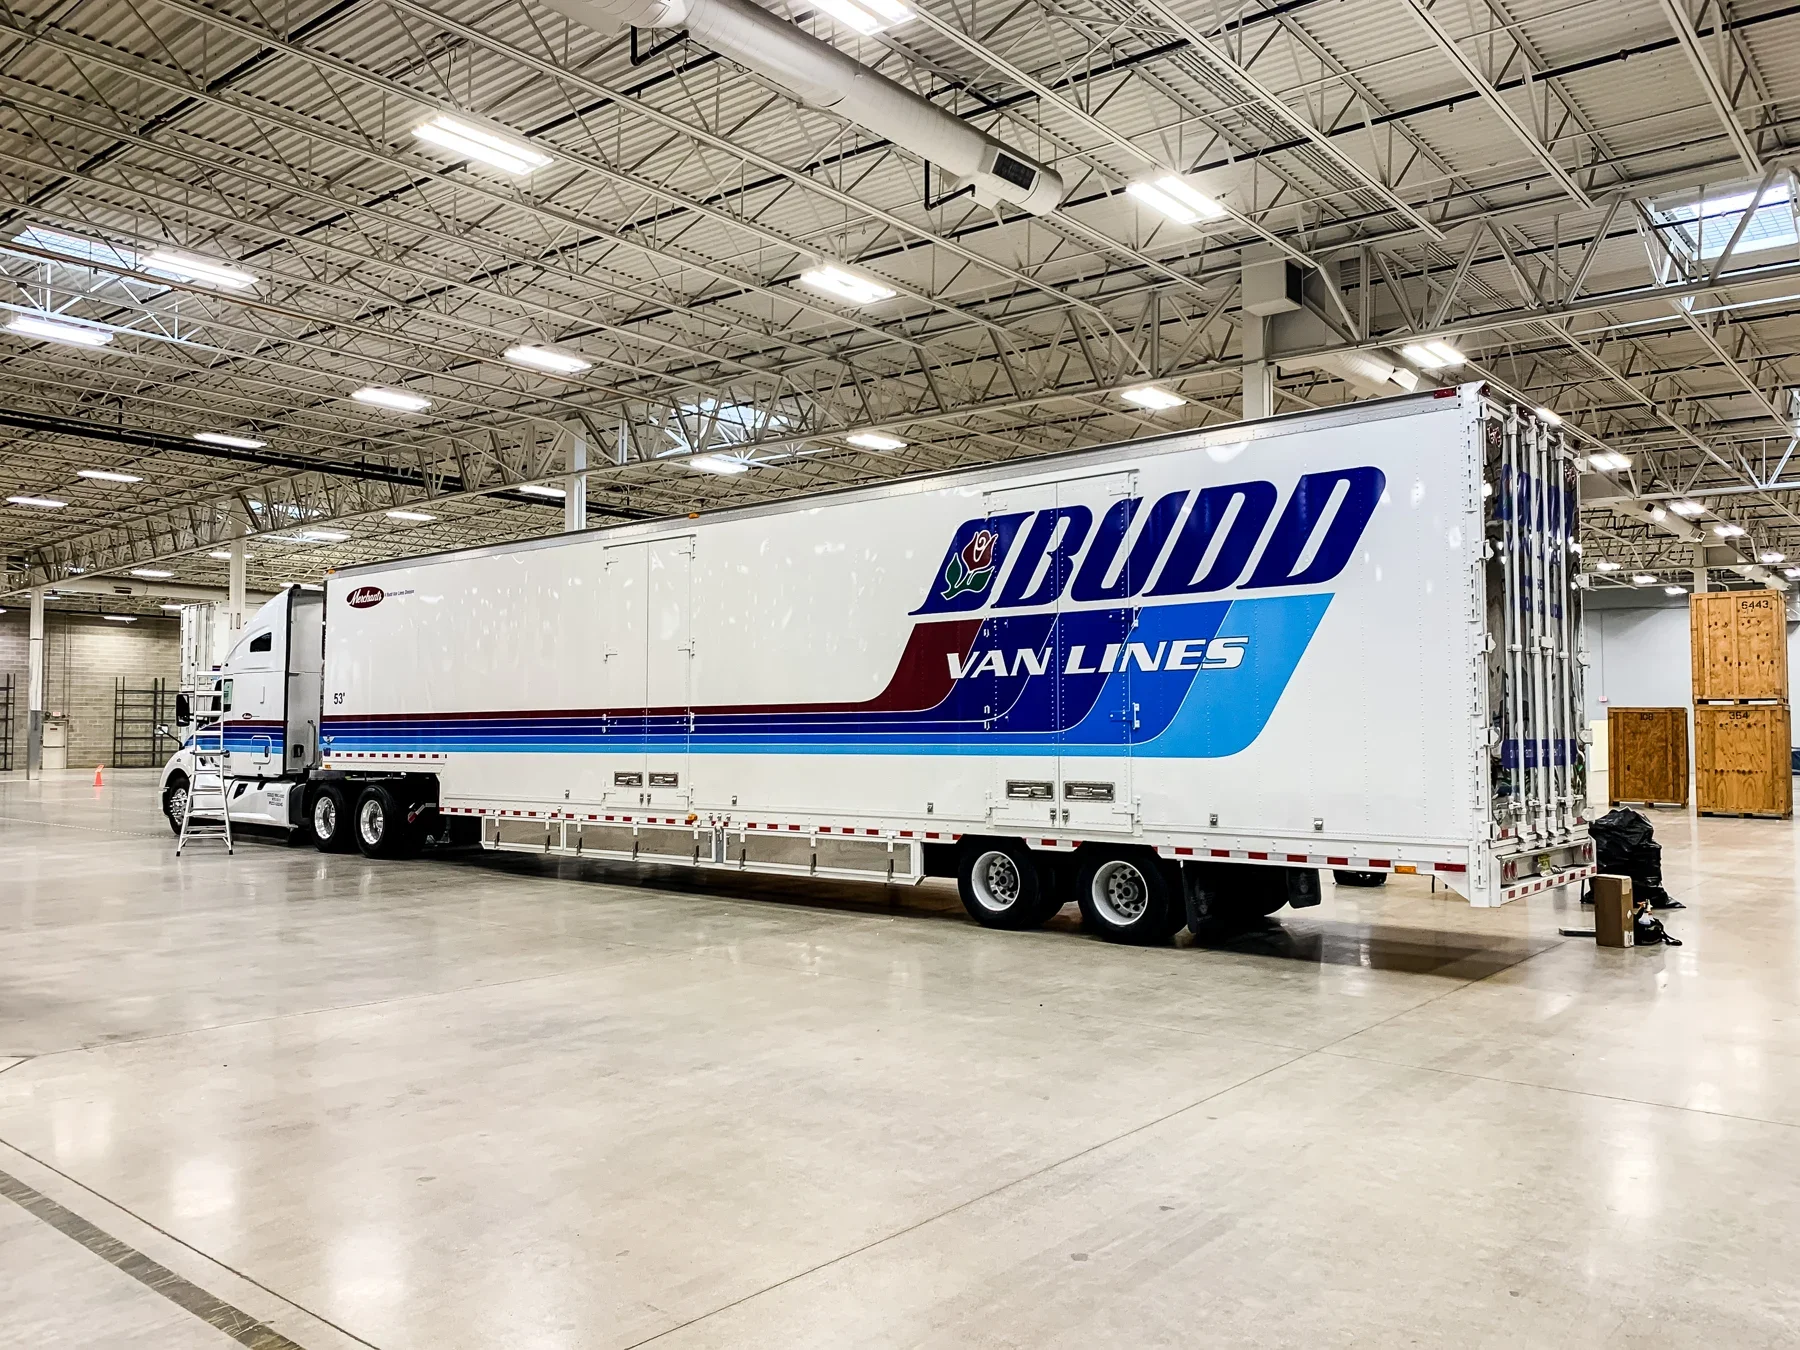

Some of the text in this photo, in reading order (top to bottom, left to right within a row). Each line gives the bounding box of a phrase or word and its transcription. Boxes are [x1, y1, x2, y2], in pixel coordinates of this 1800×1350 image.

[990, 466, 1386, 609] BUDD
[348, 589, 383, 605] Merchants
[1741, 600, 1769, 610] 6443
[946, 635, 1250, 680] VAN LINES
